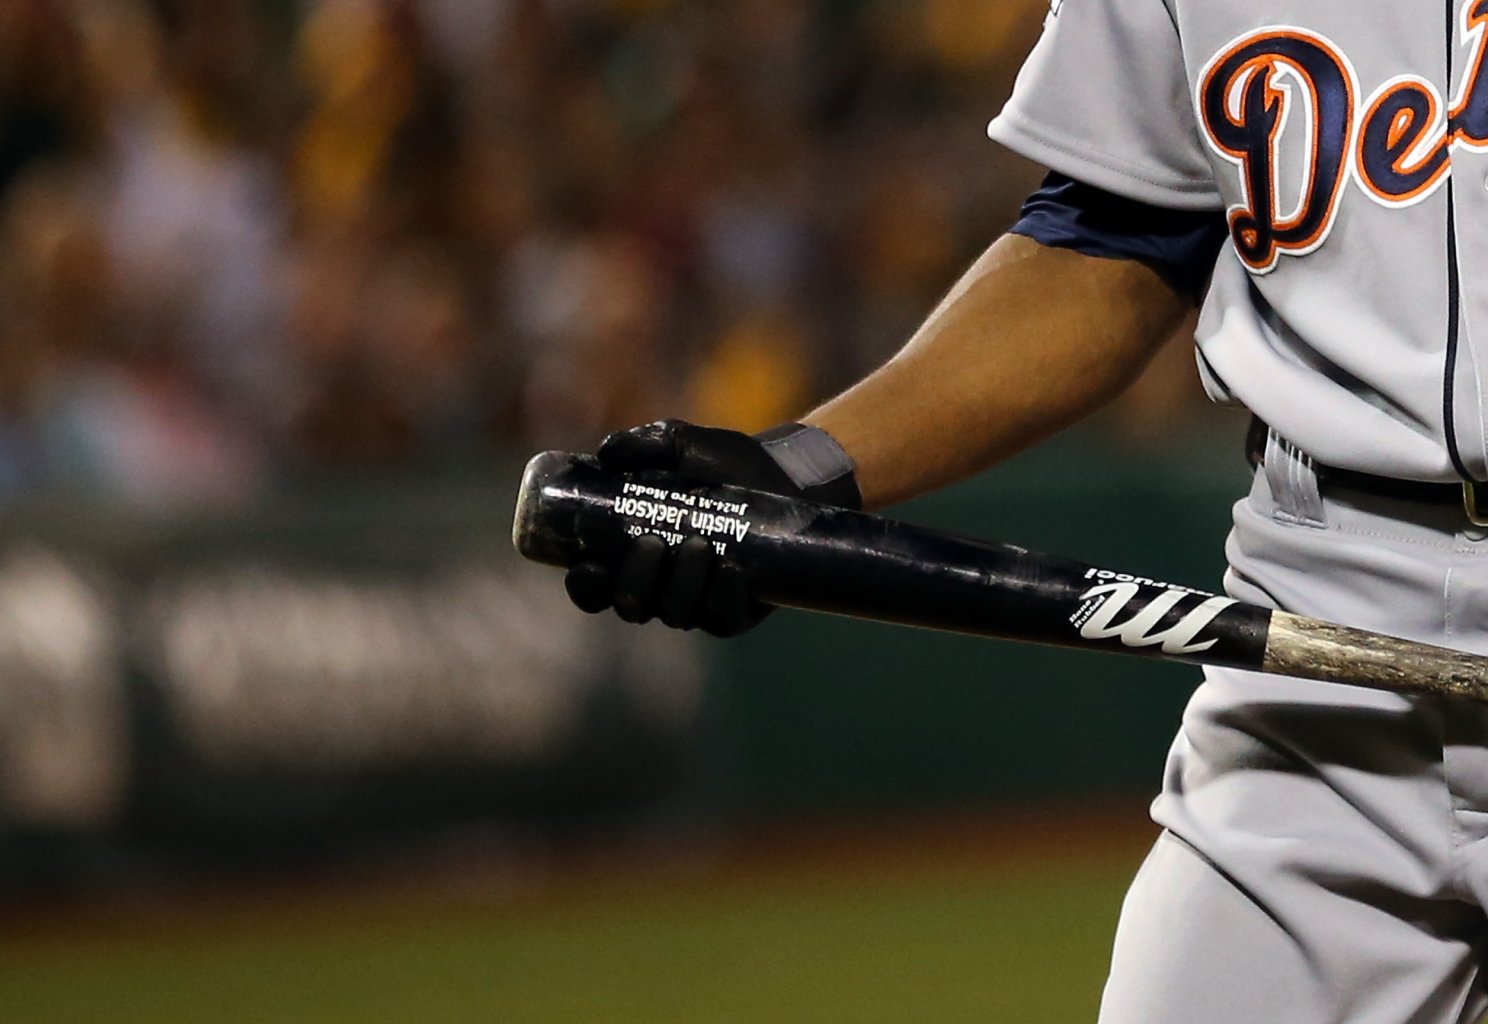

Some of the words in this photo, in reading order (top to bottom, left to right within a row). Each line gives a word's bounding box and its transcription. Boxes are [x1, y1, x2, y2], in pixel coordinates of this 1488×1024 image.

[623, 483, 669, 500] Model
[671, 492, 695, 506] Pro
[614, 496, 689, 530] Jackson
[691, 510, 751, 543] Austin
